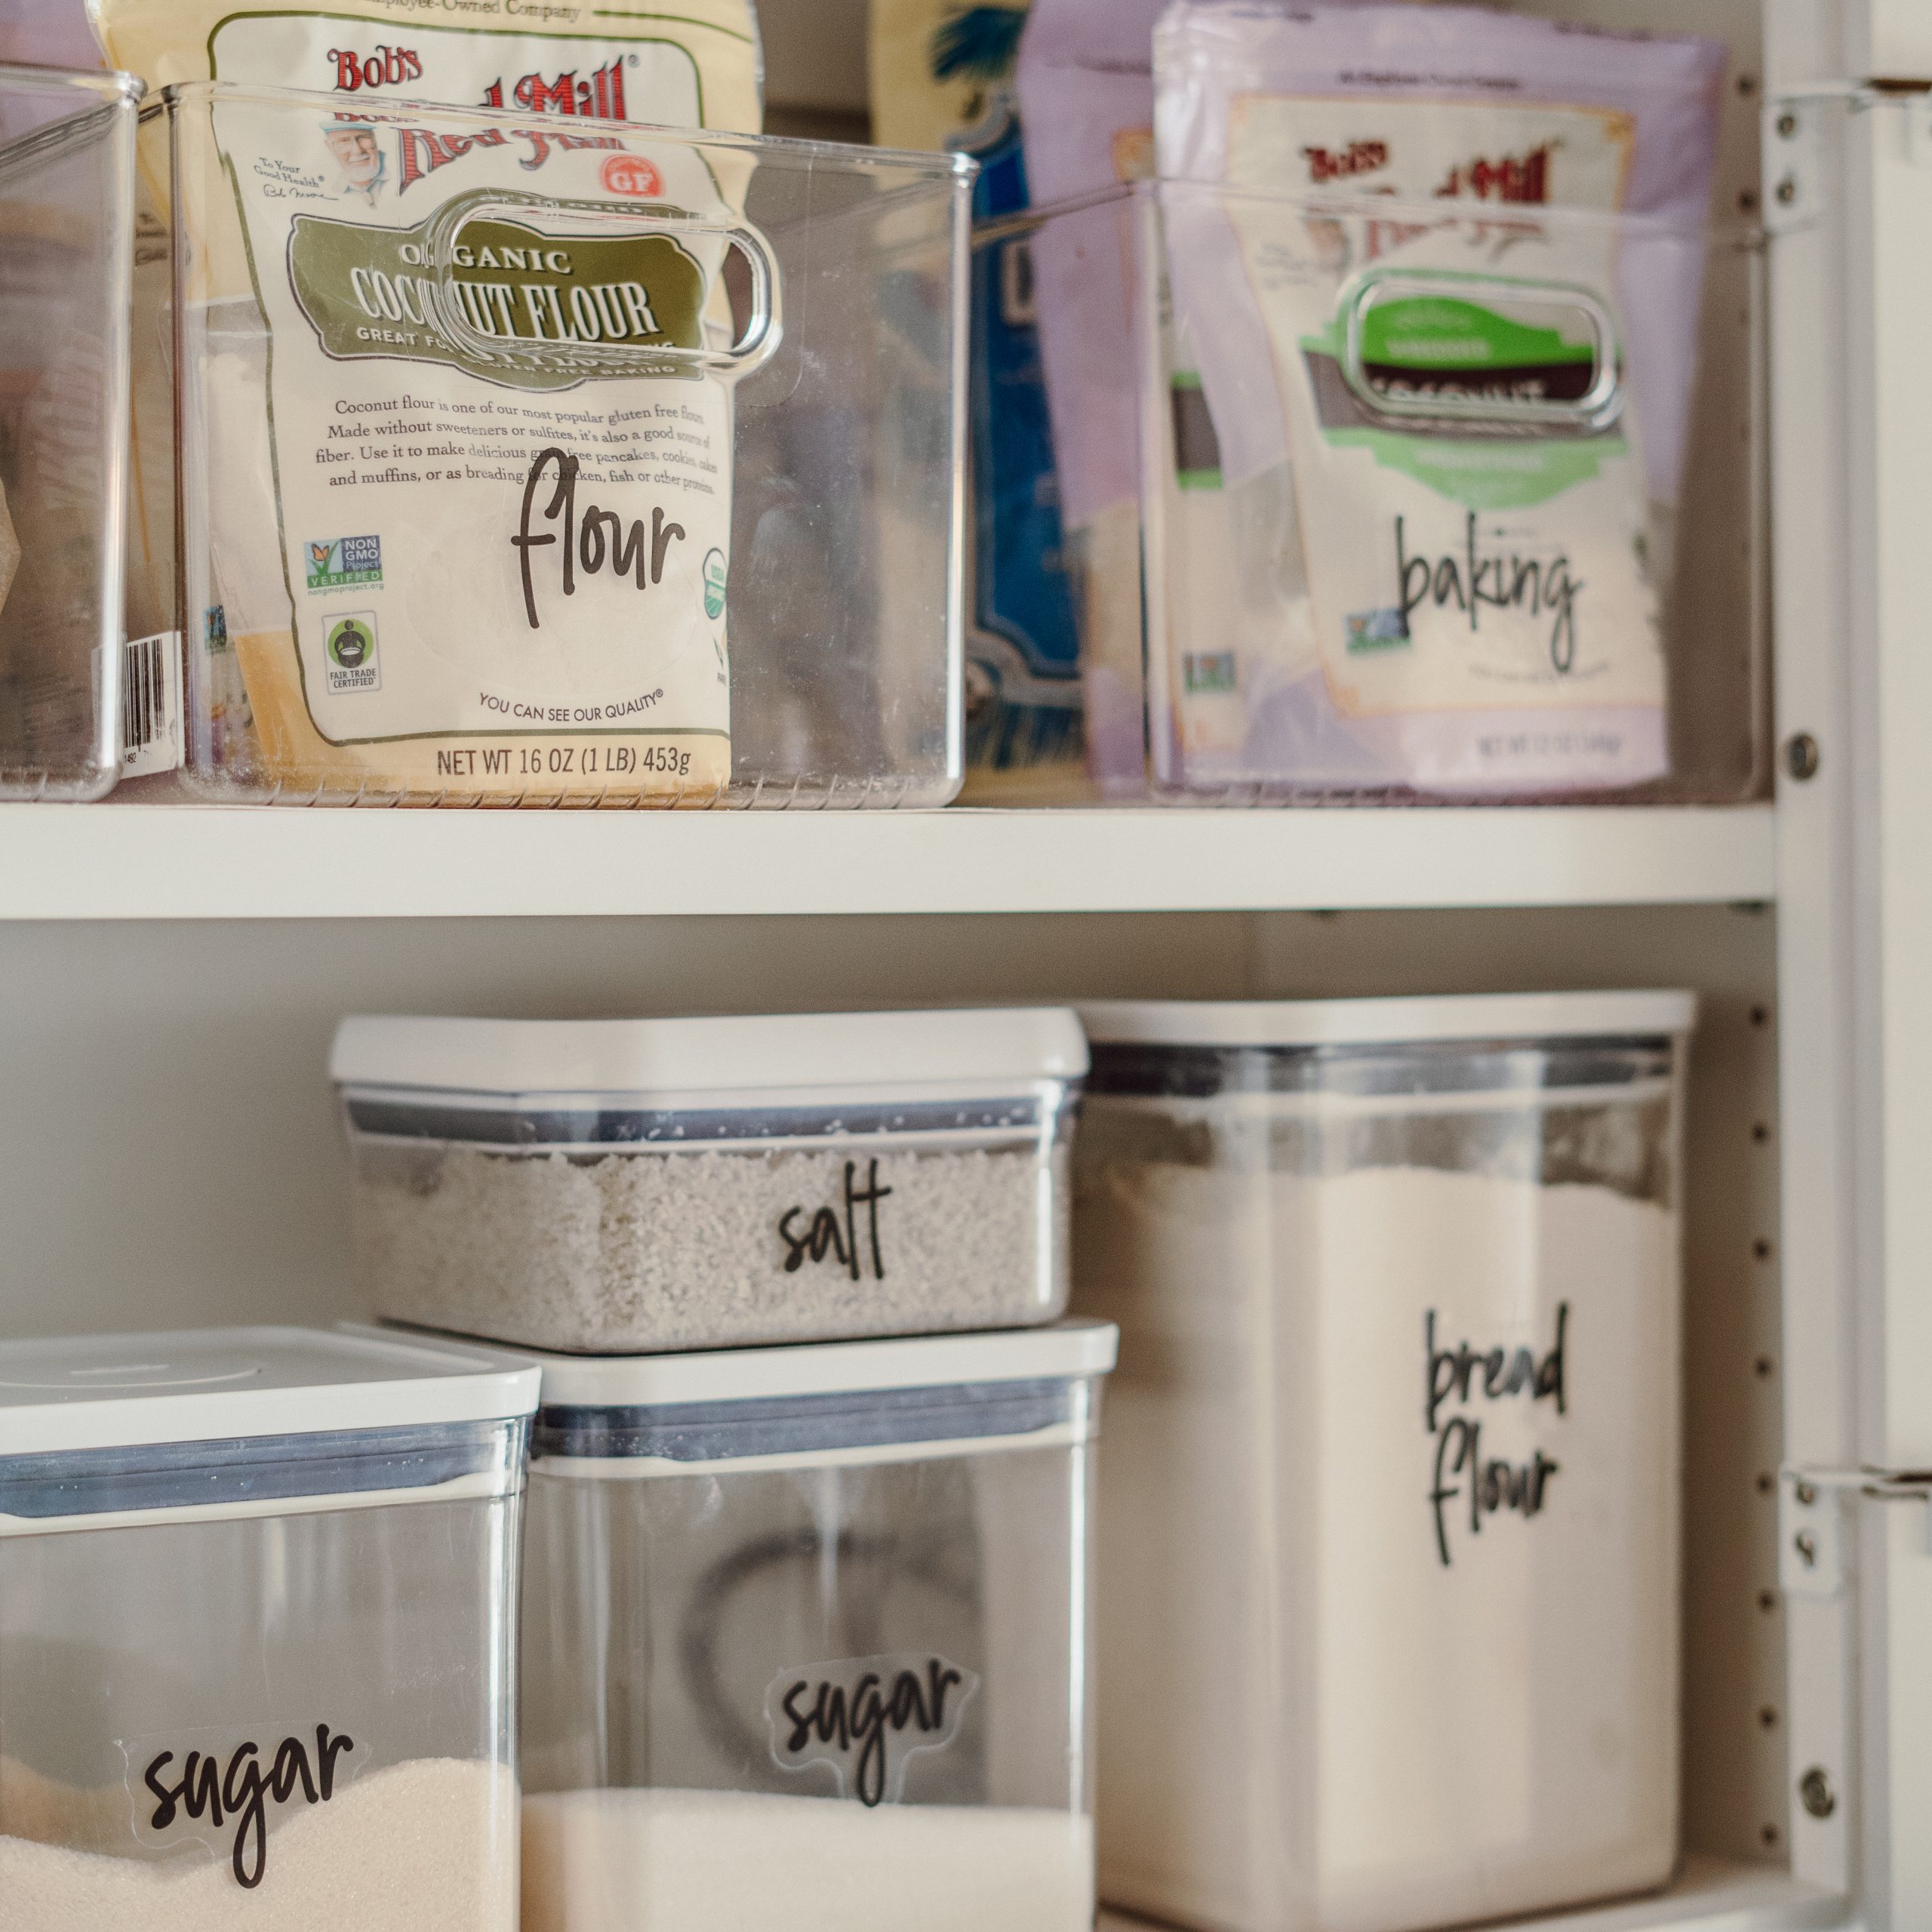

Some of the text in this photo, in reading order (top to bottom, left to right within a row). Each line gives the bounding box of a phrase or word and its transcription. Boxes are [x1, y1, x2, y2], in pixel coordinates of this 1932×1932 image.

[361, 0, 581, 23] poyee-Owned Company
[328, 45, 423, 91] Bob's
[254, 165, 281, 180] Good
[275, 160, 300, 173] Your
[610, 171, 653, 192] GF
[400, 243, 573, 275] OGANIC
[350, 266, 663, 342] COCUT FLOUR
[356, 326, 455, 355] GREAT FO
[335, 399, 398, 414] Coconut
[402, 395, 435, 409] flour
[439, 398, 449, 411] is
[451, 404, 476, 414] one
[480, 401, 494, 414] of
[497, 406, 518, 415] our
[522, 408, 551, 420] most
[555, 411, 604, 424] popular
[608, 408, 652, 426] gluten
[654, 404, 678, 419] free
[328, 423, 371, 438] Made
[374, 420, 432, 435] without
[436, 423, 508, 435] sweeteners
[512, 426, 525, 435] or
[529, 426, 577, 441] sulfites,
[580, 429, 598, 442] it's
[601, 429, 629, 443] also
[632, 431, 641, 440] a
[644, 426, 674, 442] good
[315, 449, 355, 463] fiber.
[359, 445, 389, 460] Use
[392, 445, 405, 458] it
[408, 447, 423, 457] to
[426, 441, 465, 456] make
[469, 444, 527, 459] delicious
[596, 448, 659, 464] pancakes,
[330, 470, 356, 486] and
[361, 467, 421, 483] muffins,
[426, 469, 441, 481] or
[446, 468, 461, 479] as
[465, 465, 524, 485] breading
[528, 466, 549, 481] fr
[552, 468, 606, 483] ccken,
[609, 469, 635, 482] fish
[638, 472, 651, 481] or
[654, 469, 681, 485] other
[345, 539, 377, 550] NON
[511, 448, 685, 629] flour
[346, 549, 378, 561] GMO
[346, 560, 378, 570] Project
[308, 583, 384, 596] nongmoproject.org
[311, 571, 380, 586] VERIFIED
[1395, 510, 1586, 673] baking
[330, 669, 377, 680] FAIR TRADE
[334, 678, 374, 688] CERTIFIED
[480, 693, 509, 713] YOU
[514, 704, 544, 720] CAN
[548, 709, 570, 721] SEE
[574, 708, 602, 721] OUR
[437, 746, 691, 776] NET WT 16 OZ (1 LB) 453g
[779, 1159, 892, 1281] salt
[1425, 1300, 1568, 1432] bread
[1429, 1416, 1558, 1567] flour
[782, 1659, 962, 1807] sugar
[144, 1724, 354, 1888] sugar
